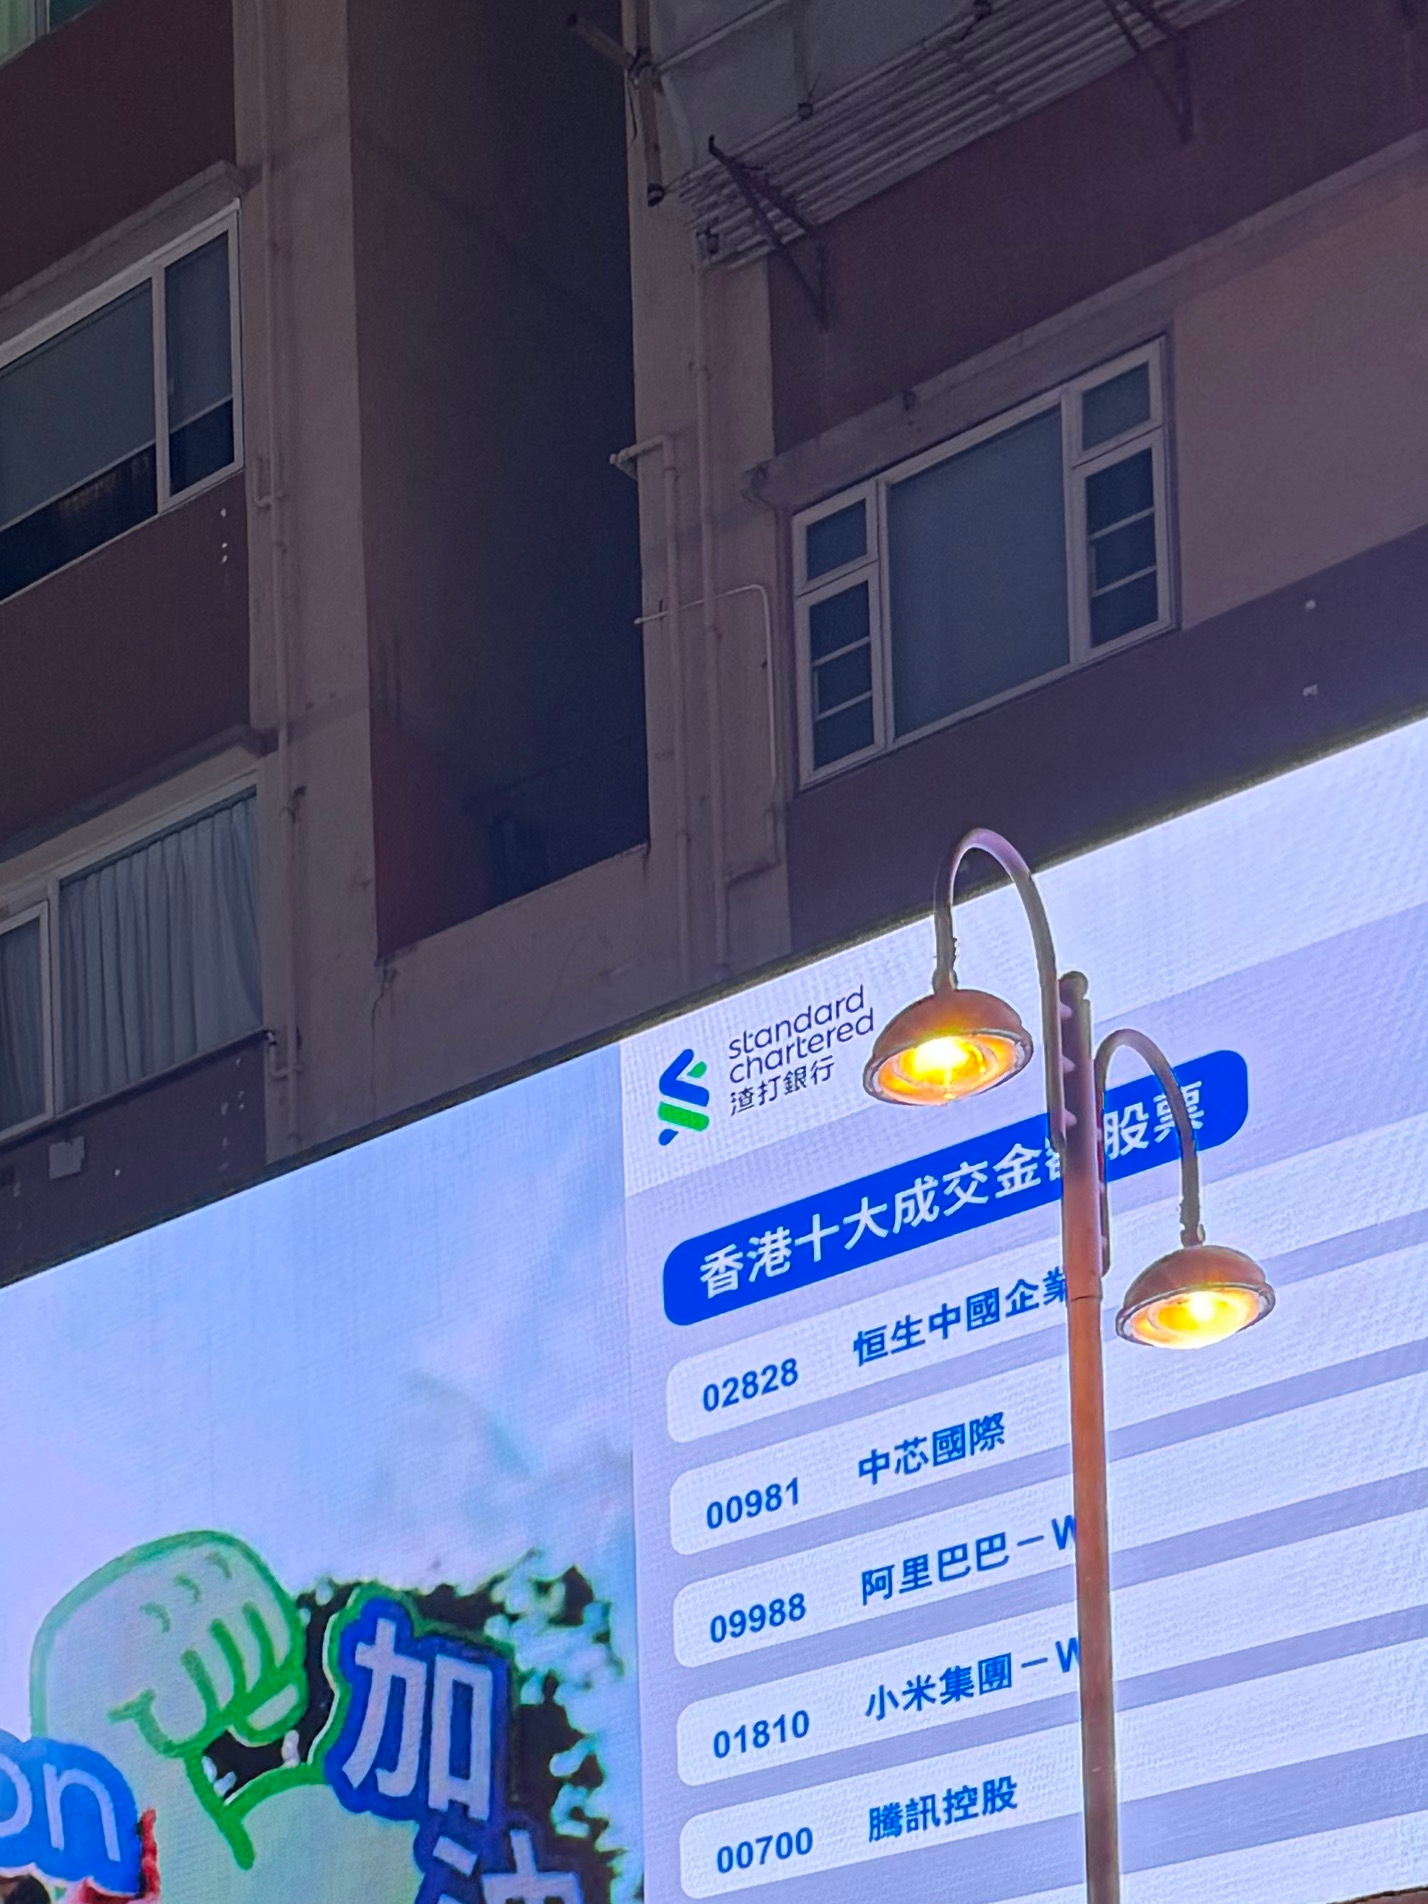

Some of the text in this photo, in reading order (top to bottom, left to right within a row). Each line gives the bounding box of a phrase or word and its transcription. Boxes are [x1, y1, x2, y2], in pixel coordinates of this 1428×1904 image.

[729, 984, 865, 1060] standard
[730, 1007, 875, 1084] chartered
[730, 1055, 835, 1117] 渣打銀行
[702, 1357, 799, 1412] 02828
[706, 1411, 1005, 1529] 00981 中芯國際
[710, 1592, 807, 1645] 09988
[713, 1709, 811, 1760] 01810
[717, 1775, 1018, 1874] 00700 騰訊控股
